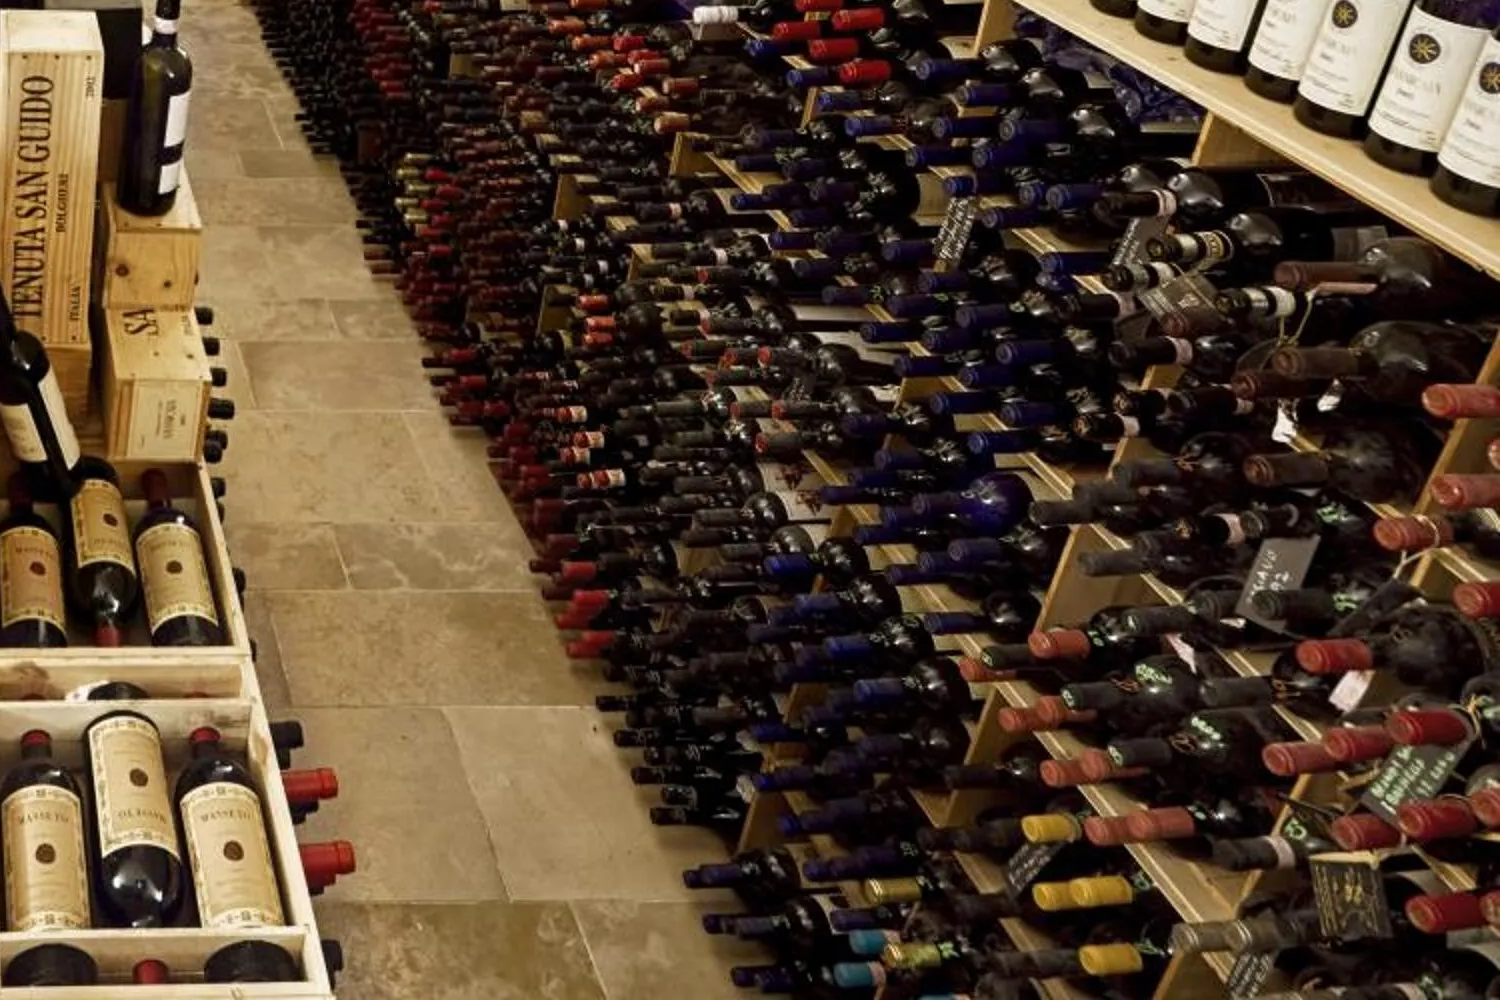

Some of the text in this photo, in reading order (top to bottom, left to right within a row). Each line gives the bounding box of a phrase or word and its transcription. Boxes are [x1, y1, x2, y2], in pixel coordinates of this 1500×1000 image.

[12, 75, 54, 317] TENUTA SAN GUIDO
